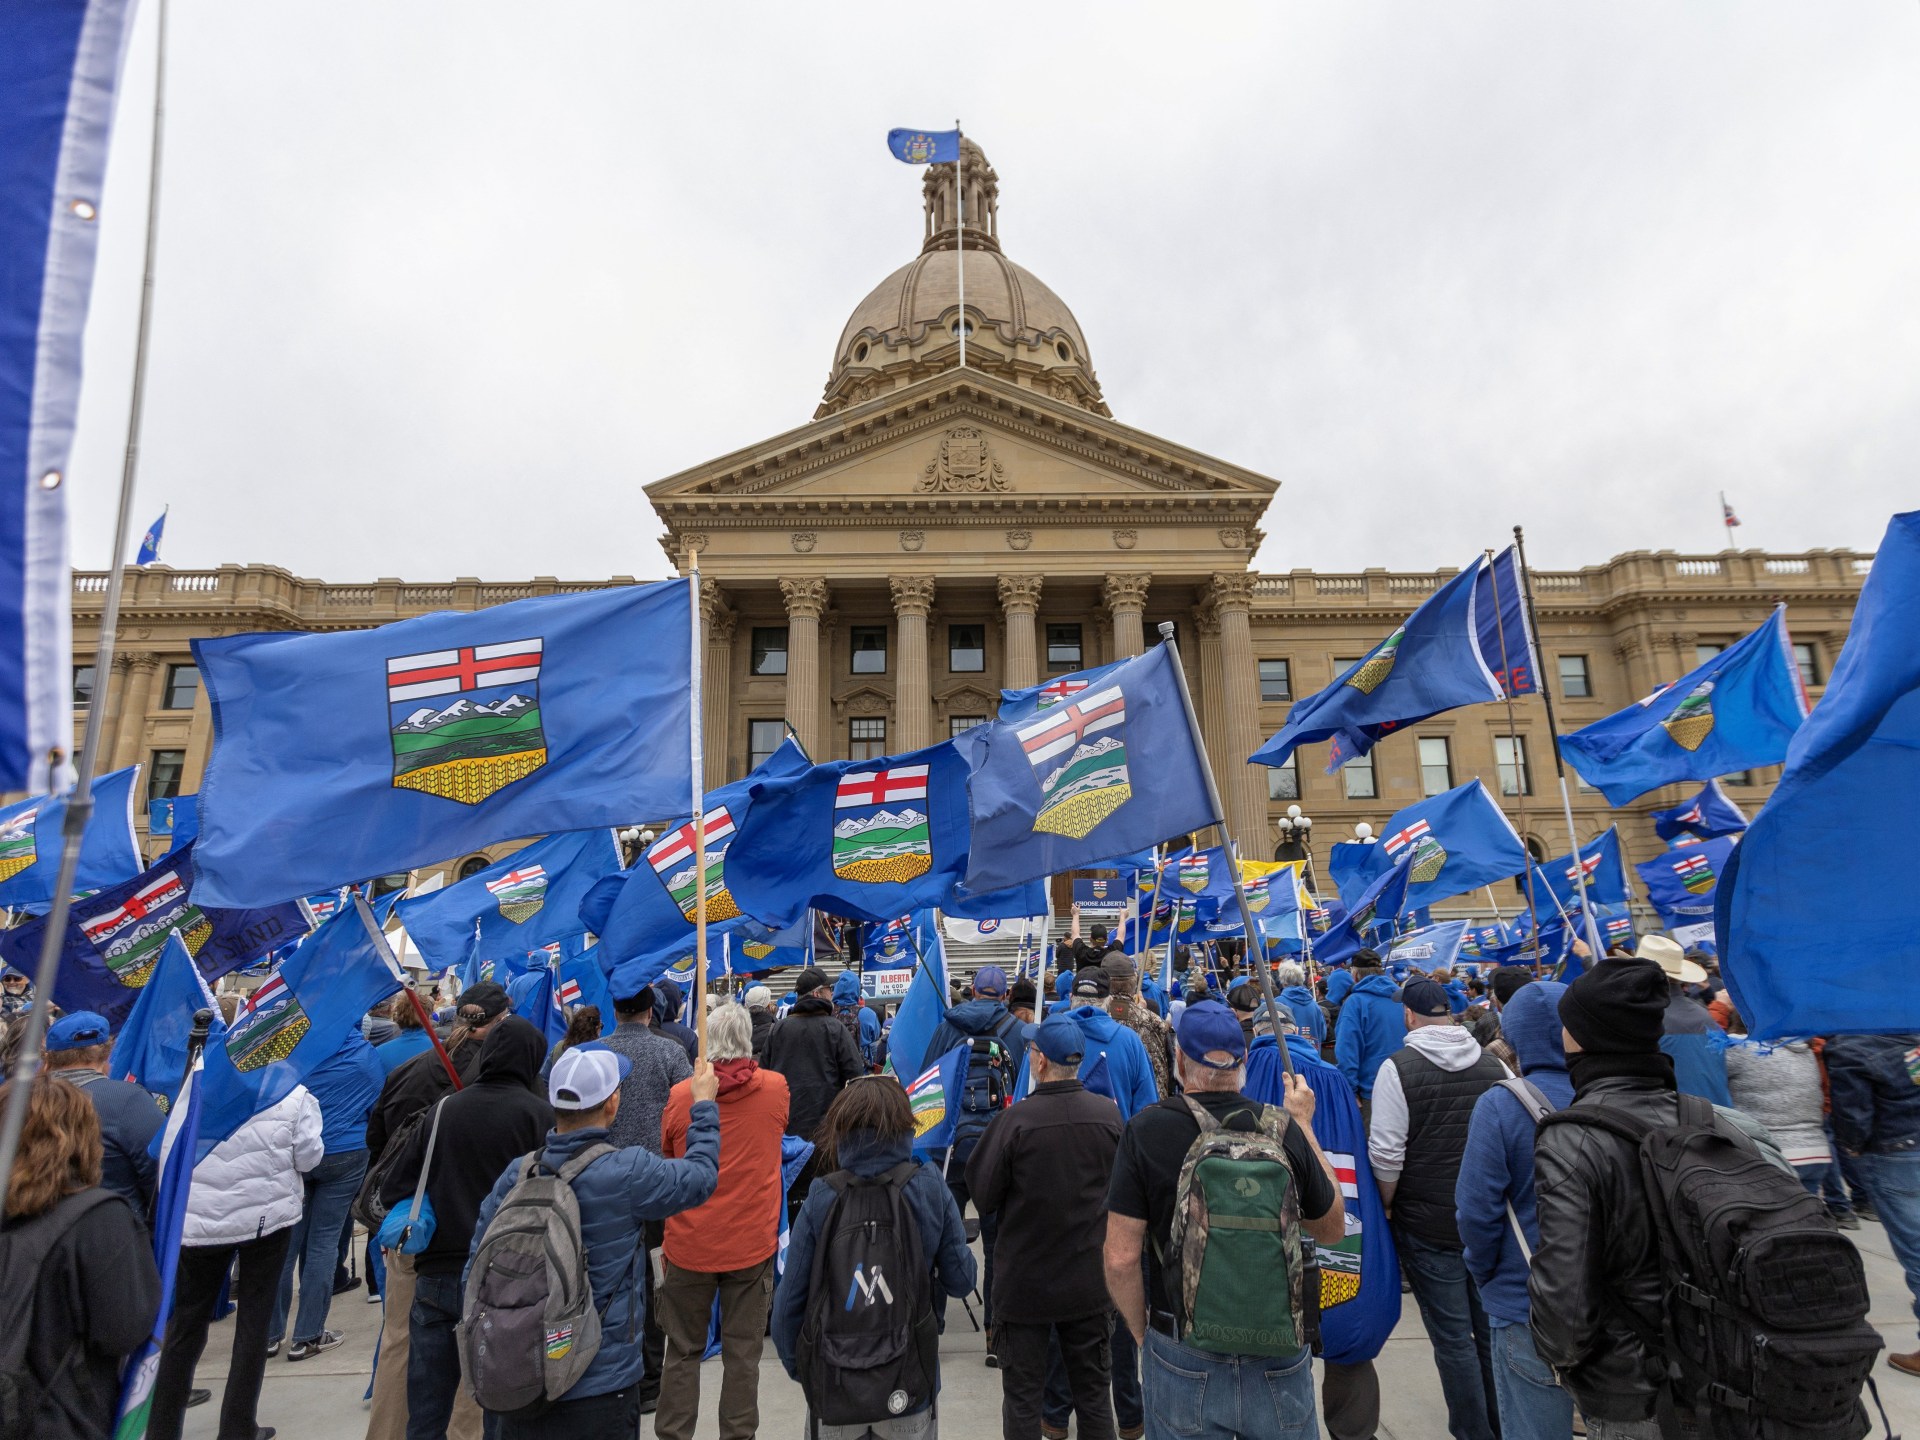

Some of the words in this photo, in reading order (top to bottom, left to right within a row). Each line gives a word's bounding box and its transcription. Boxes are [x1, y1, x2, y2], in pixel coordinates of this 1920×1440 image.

[1494, 667, 1530, 692] EE
[84, 907, 138, 941] Your
[139, 880, 187, 911] Free
[139, 914, 175, 940] Can
[881, 974, 911, 984] ALBERTA
